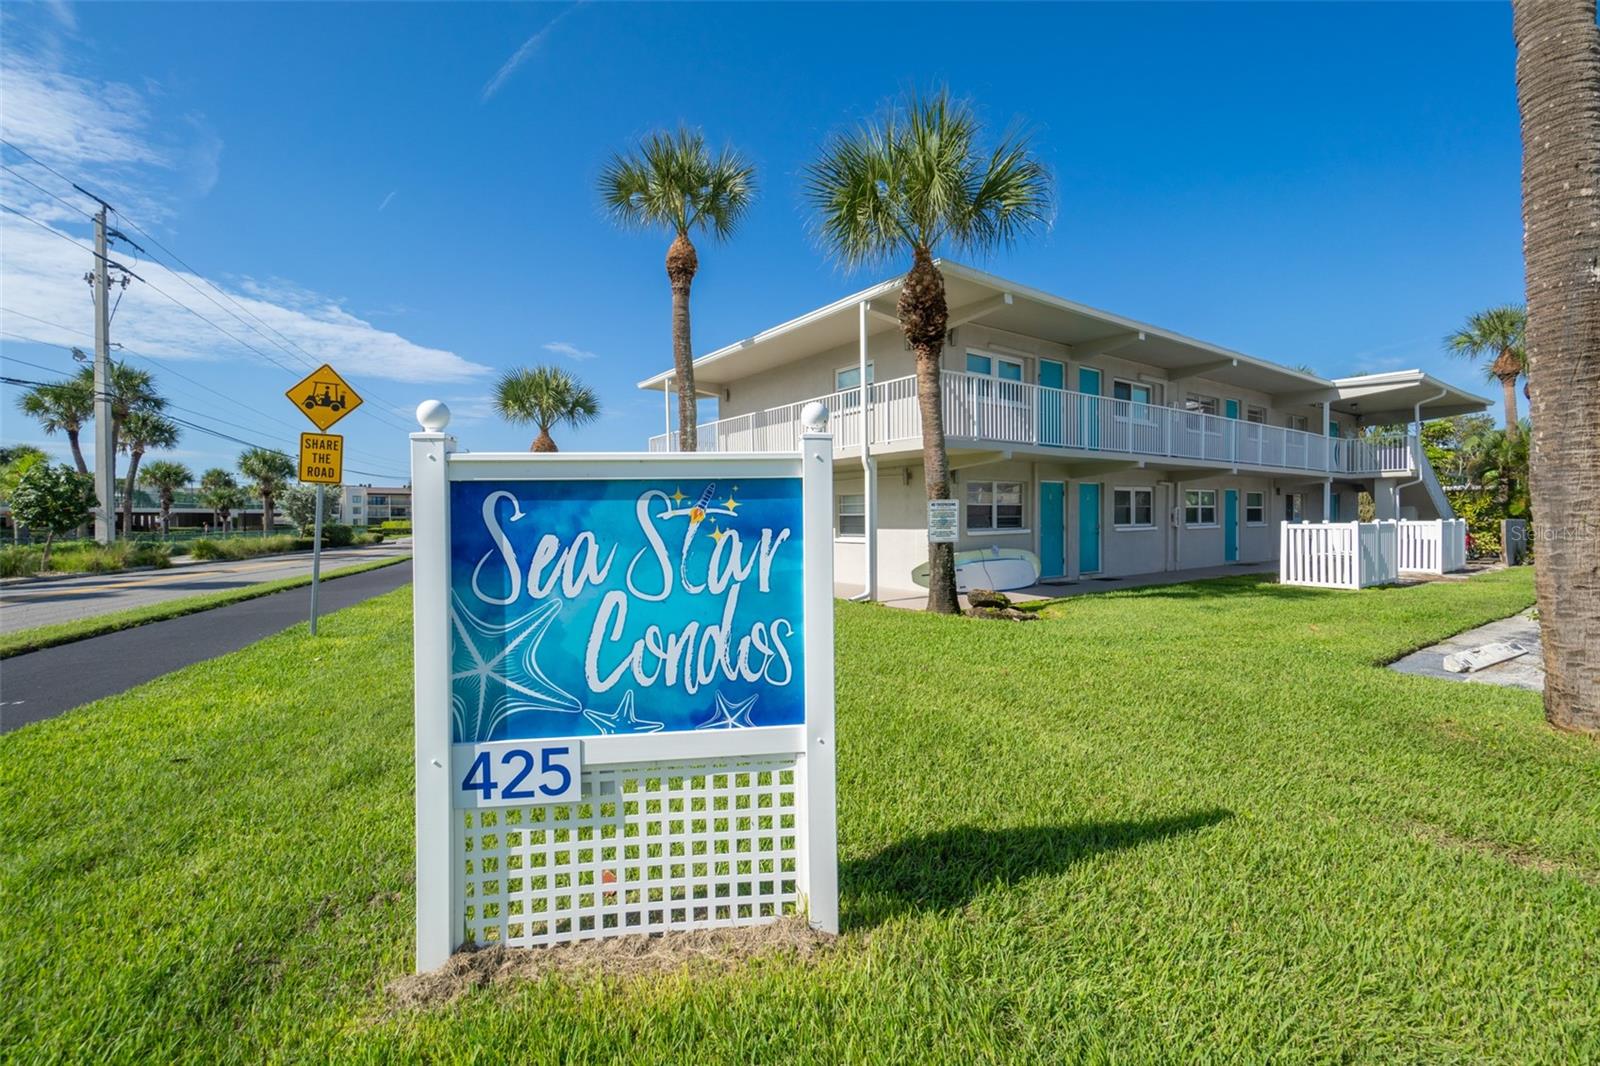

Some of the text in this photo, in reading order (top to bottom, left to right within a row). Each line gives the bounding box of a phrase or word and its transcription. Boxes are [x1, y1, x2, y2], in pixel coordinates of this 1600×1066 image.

[305, 438, 339, 451] SHARE
[312, 452, 331, 464] THE
[307, 466, 334, 478] ROAD
[471, 485, 791, 605] Sea Star
[585, 584, 794, 695] Condos
[461, 746, 572, 800] 425
